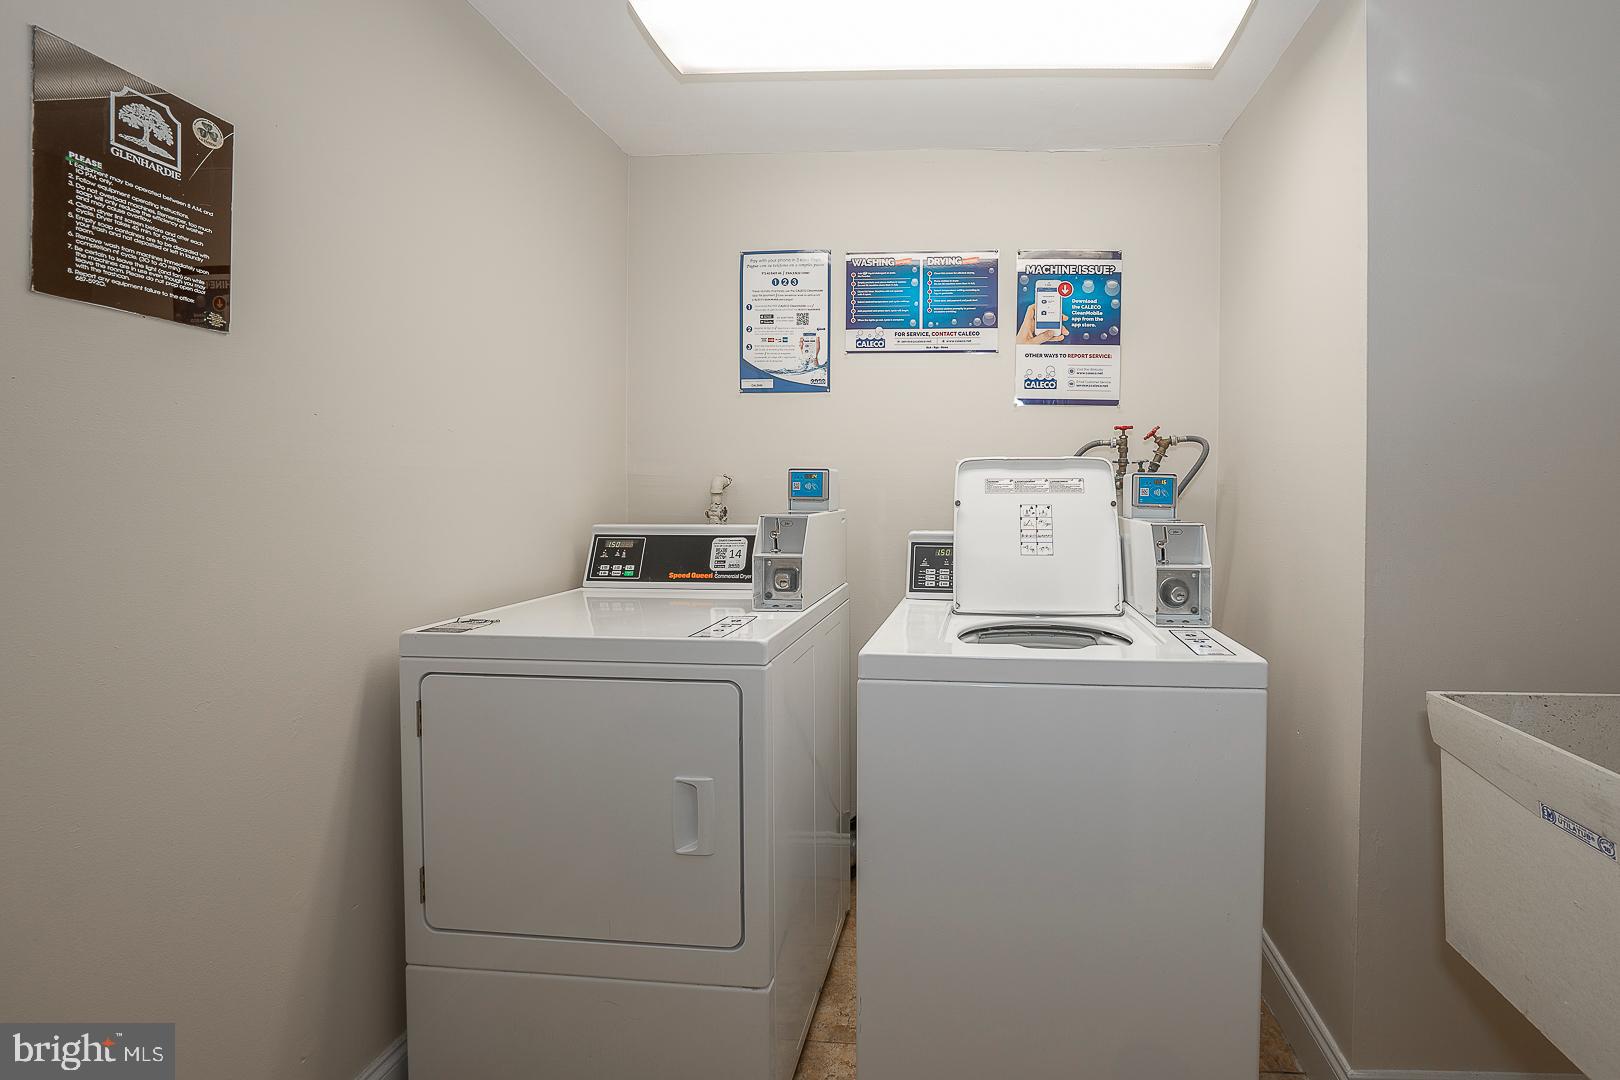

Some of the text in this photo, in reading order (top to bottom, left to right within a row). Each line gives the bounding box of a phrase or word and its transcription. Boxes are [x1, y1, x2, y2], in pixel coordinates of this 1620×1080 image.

[68, 150, 102, 169] PLEASE
[110, 146, 181, 180] GLENHARDIE
[74, 162, 108, 178] Equipment
[109, 175, 123, 184] may
[134, 184, 161, 198] operated
[162, 194, 186, 206] between
[75, 175, 96, 186] Follow
[97, 183, 130, 198] equipment
[131, 195, 159, 209] operating
[75, 189, 92, 198] soap
[93, 194, 103, 202] will
[104, 198, 117, 207] only
[118, 203, 140, 214] reduce
[141, 210, 151, 218] the
[75, 194, 89, 202] and
[90, 200, 105, 208] may
[106, 205, 125, 214] cause
[86, 186, 97, 194] not
[99, 191, 126, 204] overload
[197, 225, 212, 233] much
[75, 201, 95, 211] Clean
[96, 208, 113, 217] dryer
[124, 218, 144, 227] screen
[144, 223, 163, 233] before
[190, 238, 203, 246] each
[75, 213, 96, 225] Empty
[97, 221, 113, 230] soap
[114, 226, 144, 239] containers
[75, 220, 90, 228] your
[91, 224, 107, 233] trash
[96, 213, 112, 223] Dryer
[114, 219, 130, 228] takes
[75, 238, 111, 253] completion
[75, 232, 102, 244] Remove
[103, 241, 120, 249] wash
[121, 245, 135, 254] from
[135, 250, 162, 261] machines
[84, 248, 107, 258] certain
[116, 256, 133, 265] leave
[87, 255, 118, 266] machines
[851, 258, 895, 267] WASHING
[927, 257, 962, 266] DRYING
[75, 262, 89, 270] with
[75, 256, 93, 265] leave
[125, 270, 144, 279] Please
[1025, 265, 1116, 275] MACHINE ISSUE?
[74, 269, 96, 279] Report
[111, 279, 143, 290] equipment
[856, 340, 885, 348] CALECO
[1025, 381, 1056, 389] CALECO
[729, 549, 742, 559] 14
